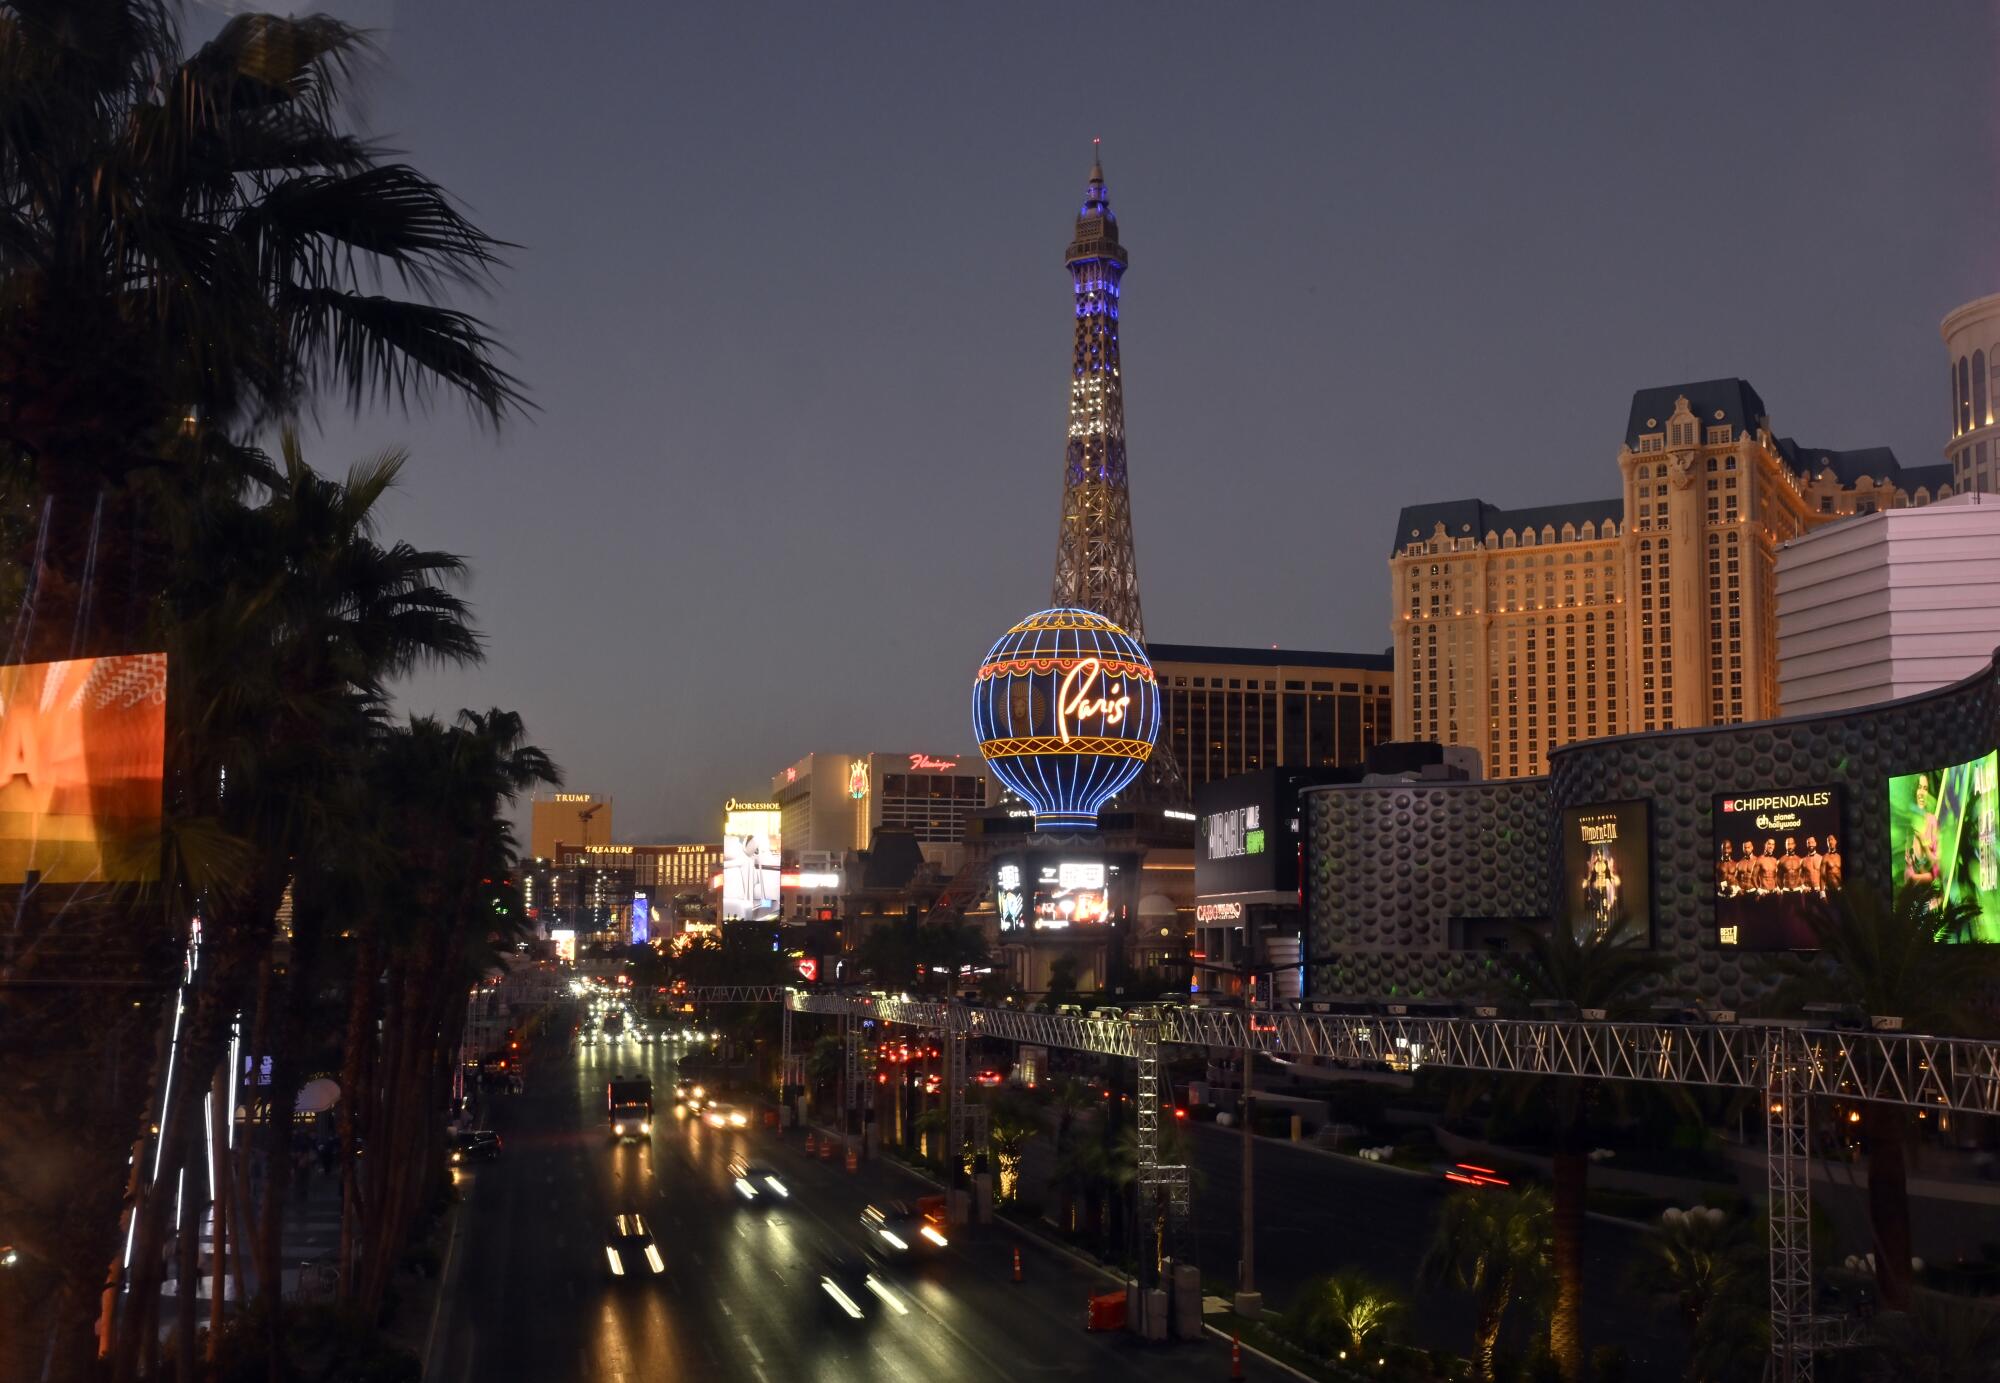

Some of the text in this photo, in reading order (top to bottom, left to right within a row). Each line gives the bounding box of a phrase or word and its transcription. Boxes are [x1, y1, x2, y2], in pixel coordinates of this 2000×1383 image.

[1058, 657, 1131, 745] Paris
[909, 754, 956, 771] Flamingo
[555, 794, 591, 802] TRUMP
[1734, 792, 1829, 812] CHIPPENDALES
[735, 802, 781, 811] HORSESHOE
[1773, 813, 1795, 822] planet
[1768, 819, 1801, 830] hollywood
[1208, 809, 1246, 859] MIRACLE
[585, 845, 705, 854] TREASURE ISLAND
